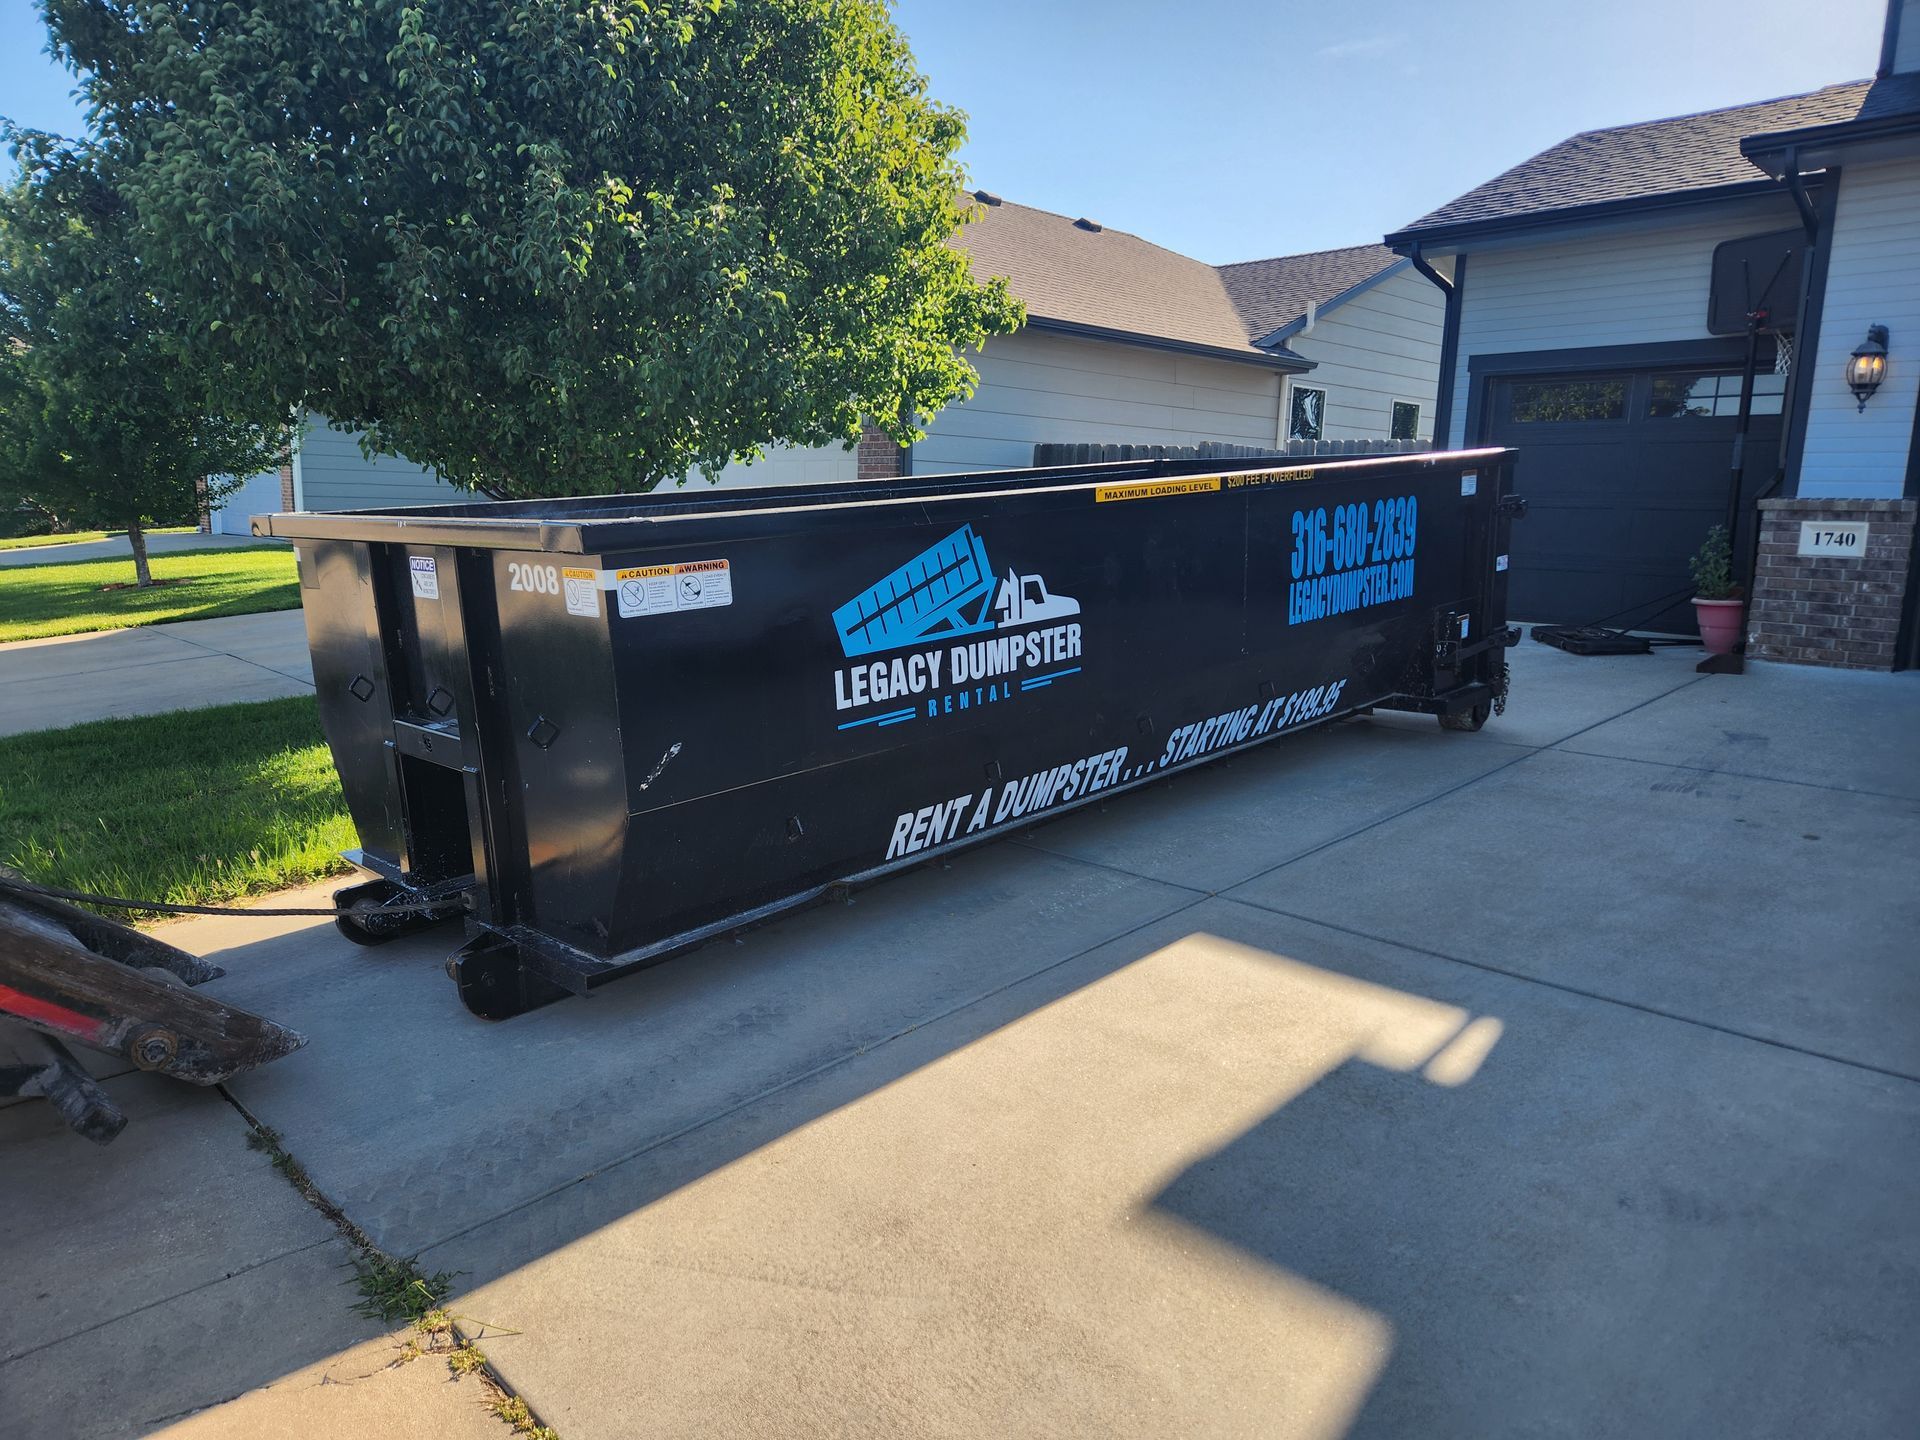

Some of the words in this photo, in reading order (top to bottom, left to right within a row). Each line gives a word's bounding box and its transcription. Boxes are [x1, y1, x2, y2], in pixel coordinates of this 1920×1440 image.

[1228, 475, 1244, 488] $200
[1246, 473, 1260, 485] FEE
[1262, 472, 1269, 484] IF
[1270, 469, 1314, 483] OVERFILLED!
[1104, 488, 1148, 500] MAXIMUM
[1150, 484, 1187, 496] LOADING
[1189, 482, 1213, 492] LEVEL
[1291, 495, 1418, 580] 316-680-2839
[1813, 532, 1856, 547] 1740
[411, 559, 434, 571] NOTICE
[569, 570, 593, 579] CAUTION
[629, 567, 670, 578] CAUTION
[683, 561, 724, 572] WARNING
[508, 562, 560, 595] 2008
[1288, 558, 1415, 626] LEGACYDUMPSTER.COM
[834, 649, 943, 711] LEGACY
[951, 623, 1082, 685] DUMPSTER
[928, 681, 1012, 718] RENTAL
[885, 794, 973, 861] RENT
[967, 787, 992, 834] A
[1159, 704, 1260, 768] STARTING
[1251, 696, 1286, 737] AT
[1277, 679, 1347, 729] $199.95
